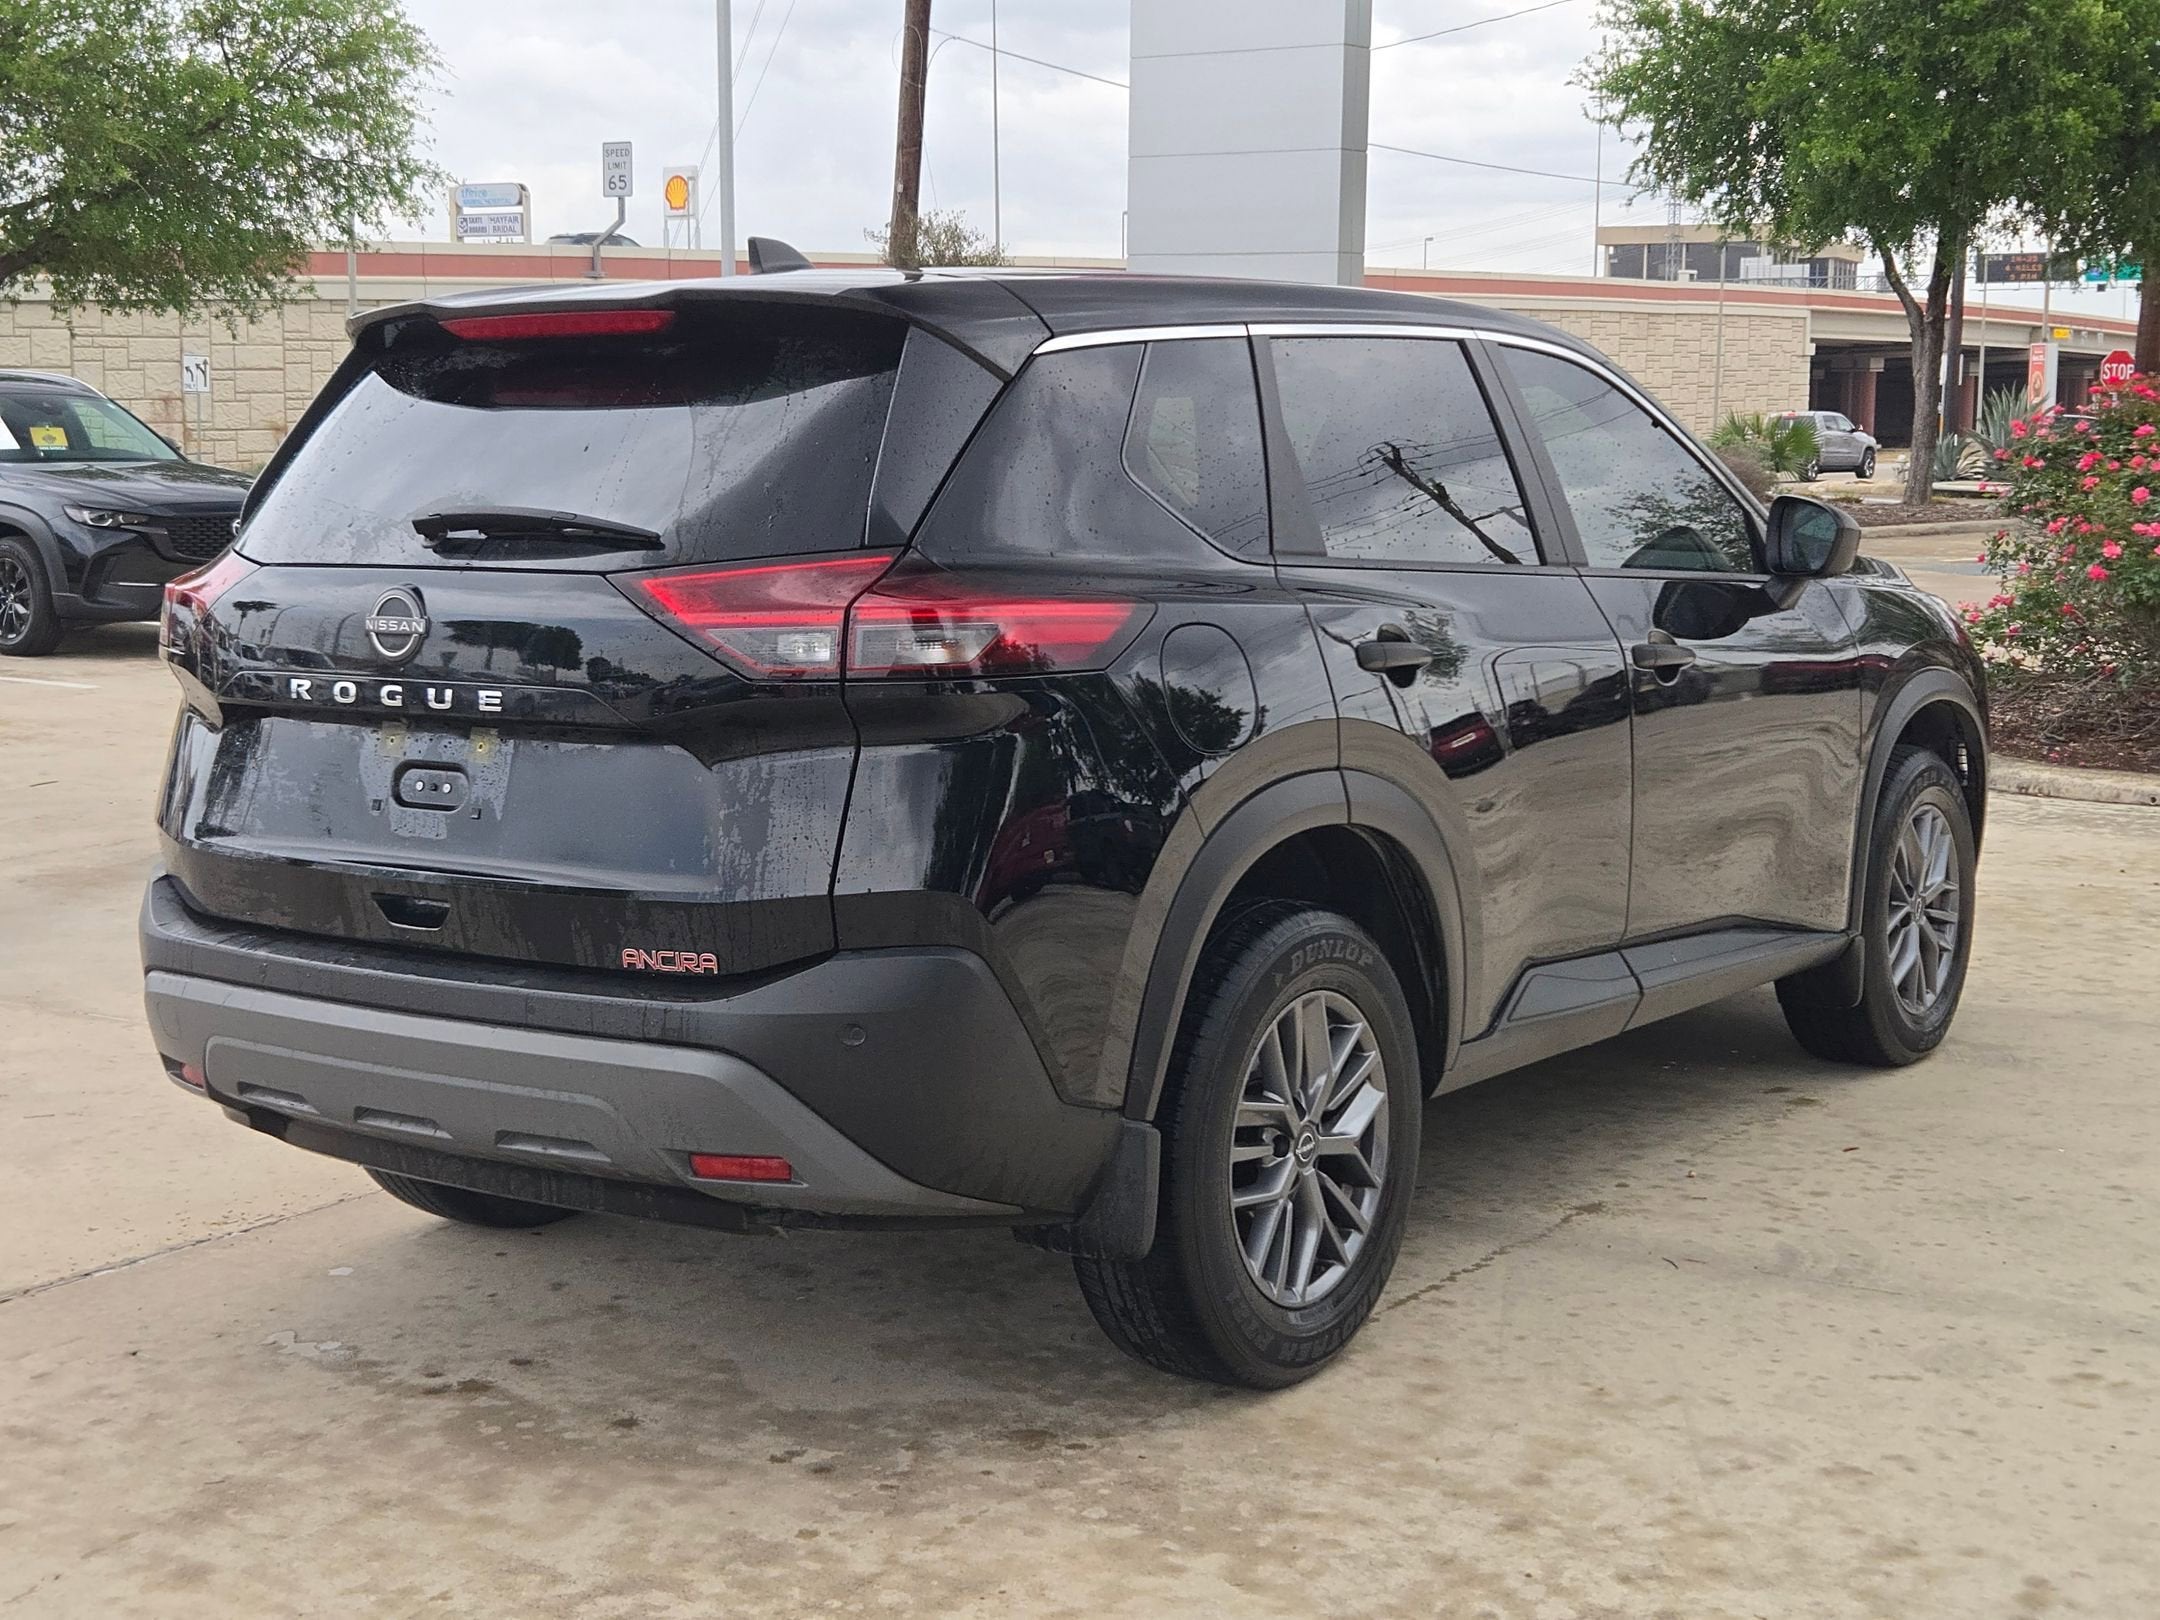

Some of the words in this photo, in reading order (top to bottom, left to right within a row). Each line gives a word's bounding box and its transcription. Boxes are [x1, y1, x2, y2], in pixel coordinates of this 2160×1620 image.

[605, 148, 630, 157] SPEED
[607, 161, 627, 171] LIMIT
[608, 174, 628, 191] 65
[489, 215, 520, 225] MAYFAIR
[492, 225, 517, 234] BRIDAL
[2103, 363, 2135, 380] STOP
[366, 619, 424, 633] NISSAN
[290, 678, 503, 712] ROGUE
[622, 948, 718, 974] ANCIRA
[1290, 939, 1373, 975] DUNLOP
